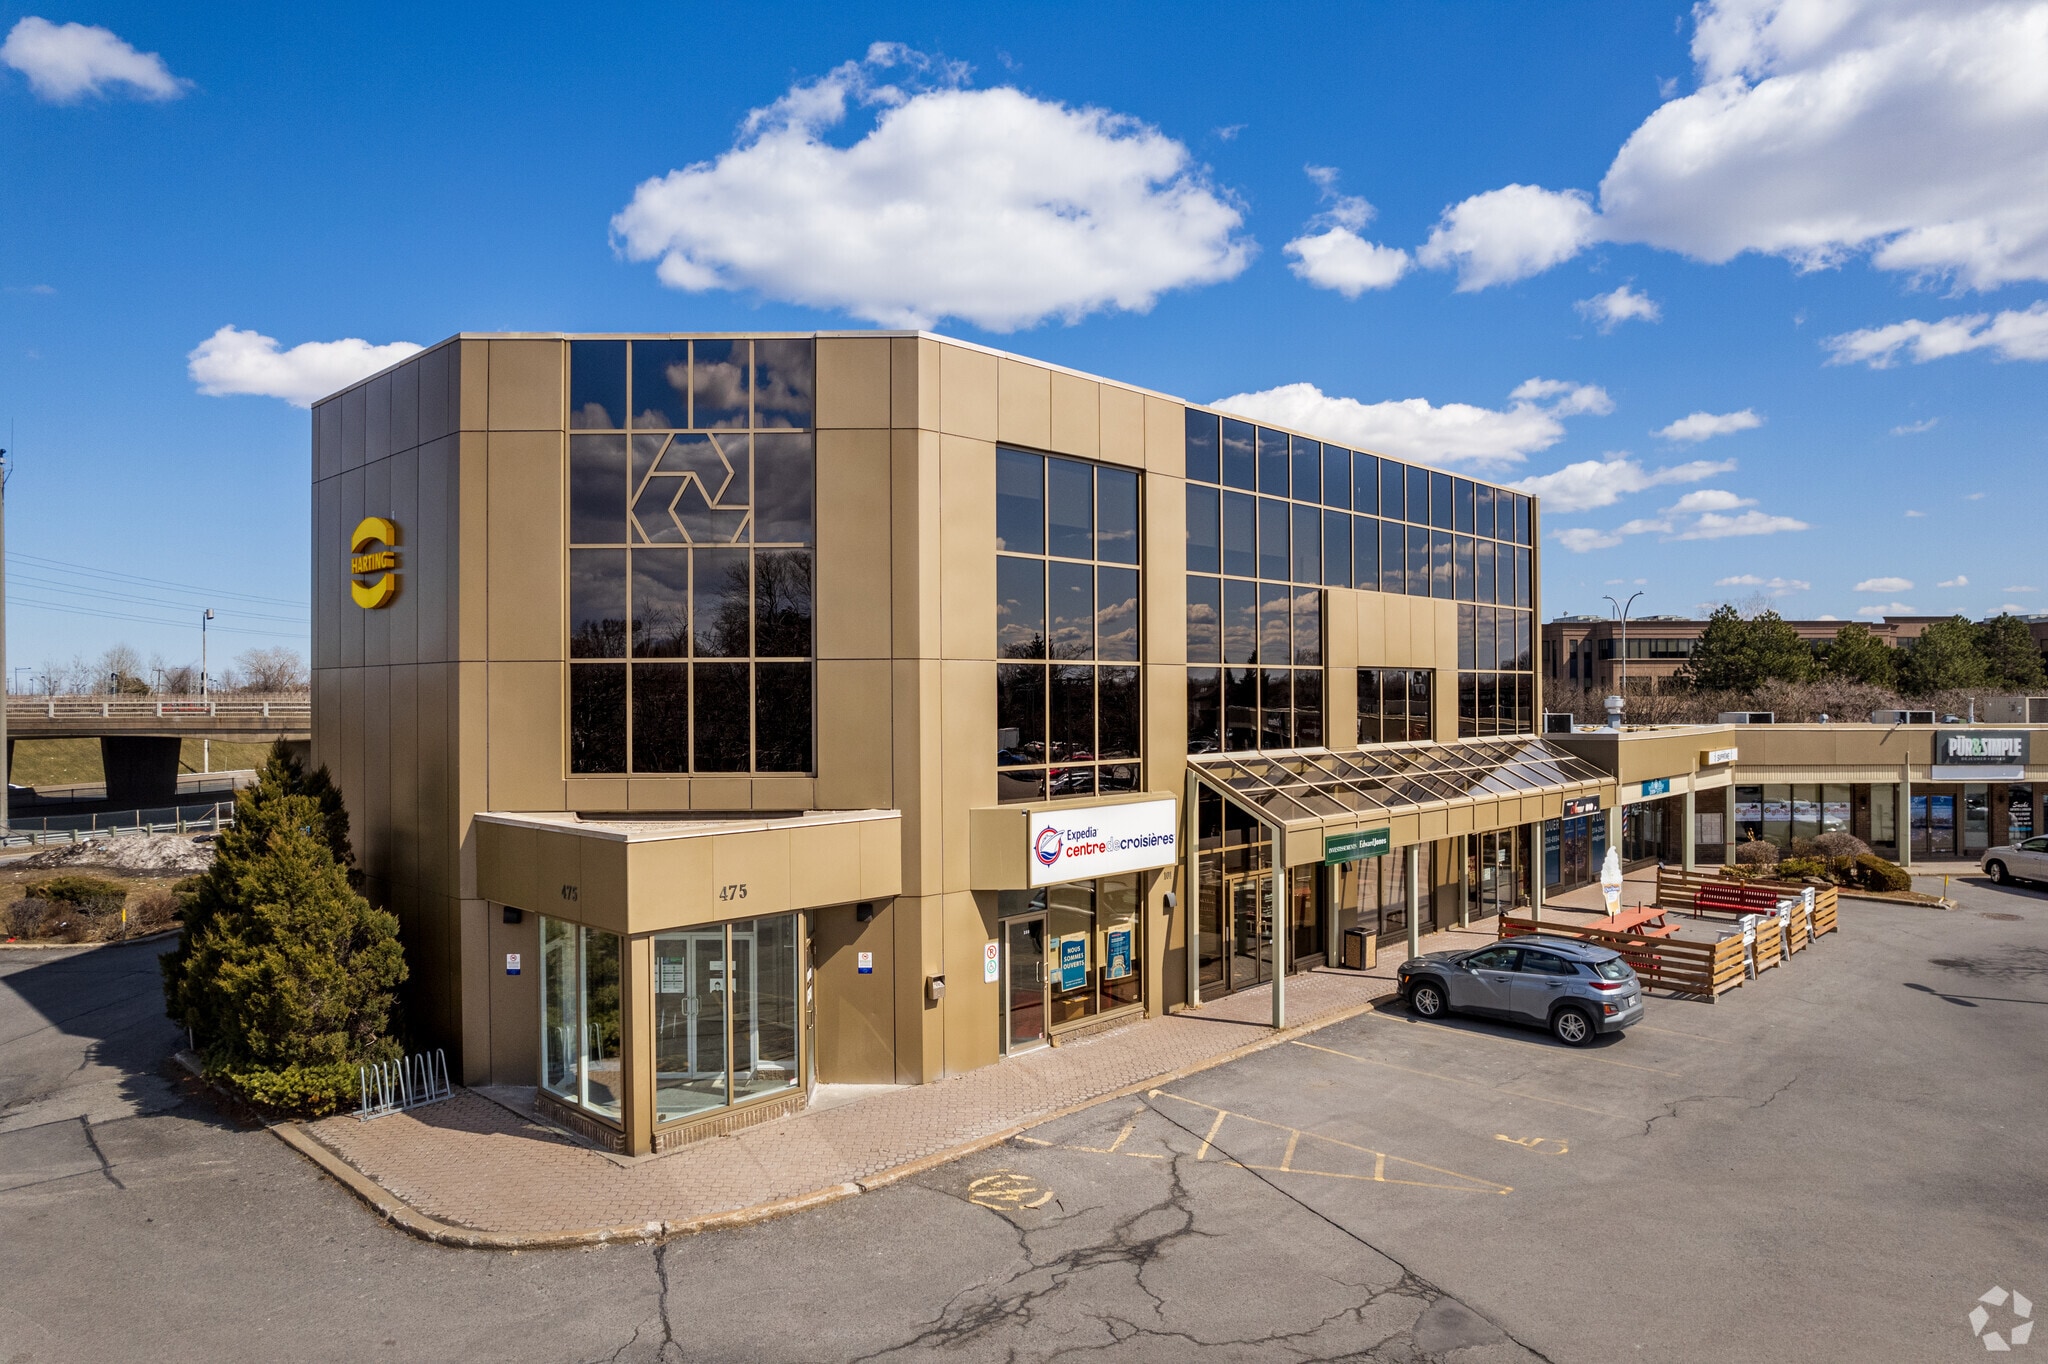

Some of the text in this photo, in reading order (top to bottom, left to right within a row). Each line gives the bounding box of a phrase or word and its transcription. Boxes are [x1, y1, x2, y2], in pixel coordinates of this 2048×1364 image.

[351, 551, 390, 574] HARTING
[1067, 826, 1097, 842] Expedia
[561, 884, 578, 902] 475
[719, 883, 748, 902] 475
[1063, 952, 1084, 963] SOMMES
[1067, 945, 1081, 954] NOUS
[1063, 960, 1085, 970] OUVERTS
